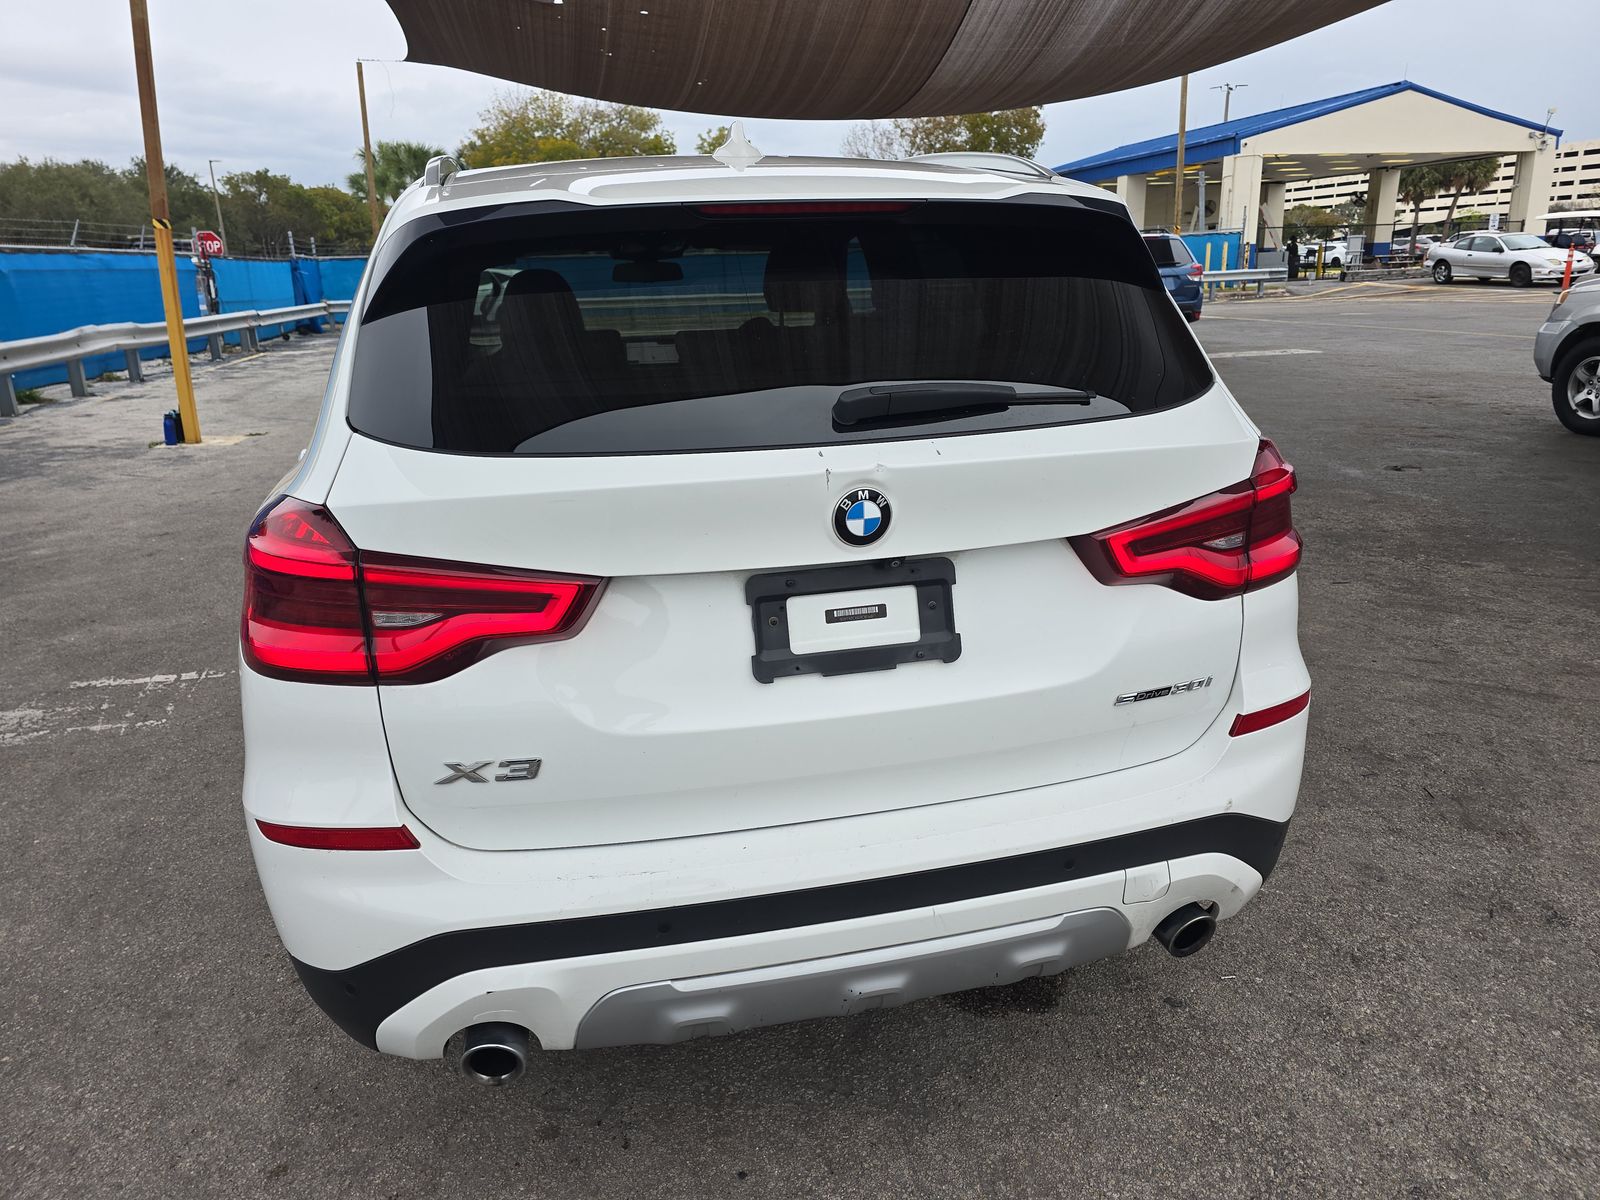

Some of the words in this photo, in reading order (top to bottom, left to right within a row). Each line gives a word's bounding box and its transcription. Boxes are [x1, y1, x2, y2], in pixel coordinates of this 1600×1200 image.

[197, 240, 221, 253] OP
[839, 489, 888, 511] BMW
[433, 757, 543, 785] X3
